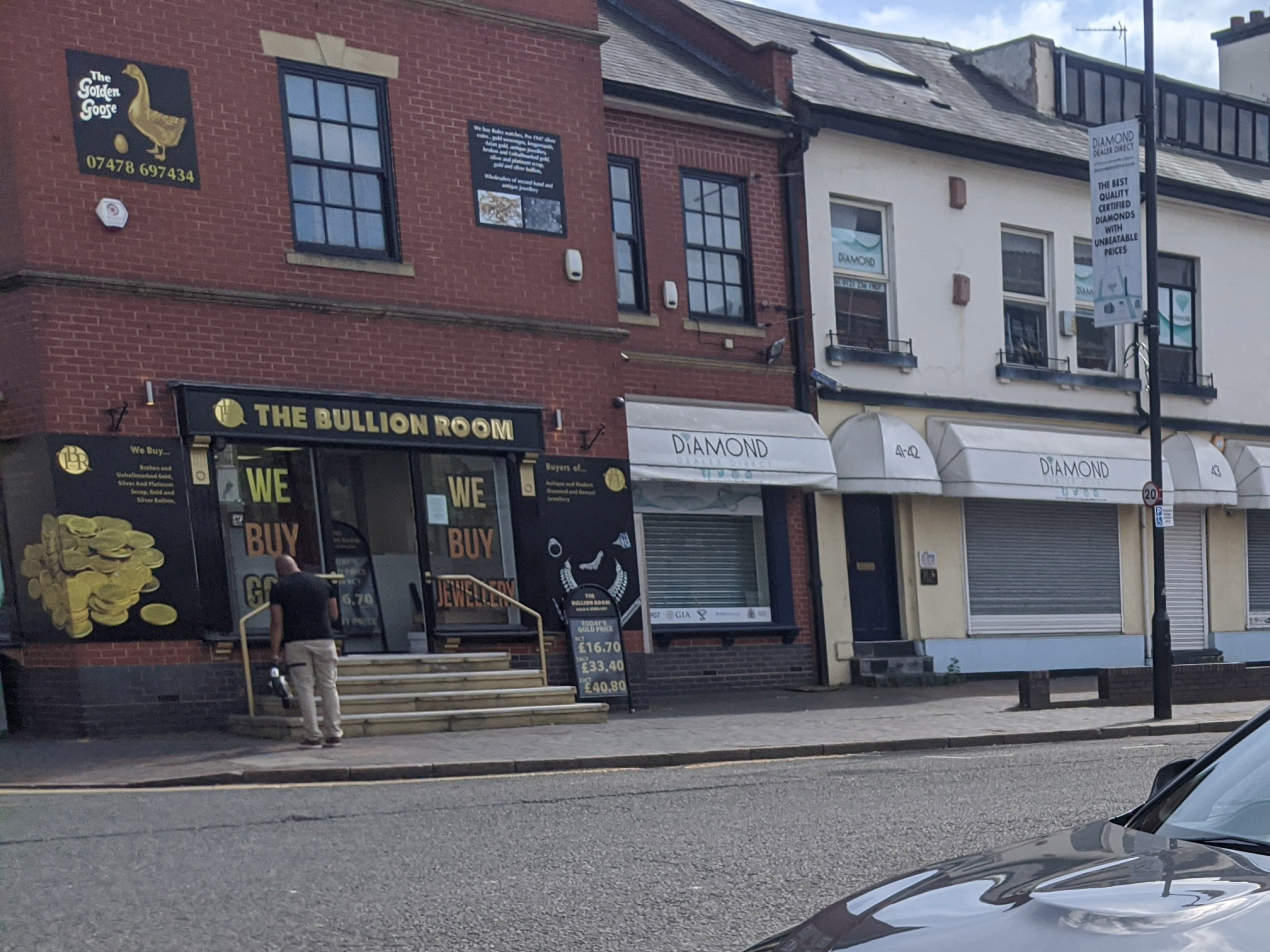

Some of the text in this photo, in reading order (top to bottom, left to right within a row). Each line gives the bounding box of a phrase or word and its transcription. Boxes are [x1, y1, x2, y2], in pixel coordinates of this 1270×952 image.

[90, 70, 112, 82] The
[77, 77, 121, 102] Golden
[79, 98, 117, 121] Goose
[1093, 142, 1134, 158] DEALER DIRECT
[86, 155, 194, 183] 07478 697434
[1098, 177, 1128, 190] THE BEST
[1099, 188, 1130, 202] QUALITY
[1098, 200, 1131, 213] CERTIFIED
[1095, 210, 1136, 224] DIAMONDS
[1104, 223, 1122, 234] WITH
[1094, 232, 1138, 248] UNBEATABLE
[1104, 245, 1127, 257] PRICES
[254, 403, 308, 429] THE
[314, 407, 429, 437] BULLION
[434, 414, 514, 441] ROOM
[130, 445, 145, 455] We
[895, 444, 921, 460] 41-42
[546, 462, 570, 472] Buyers
[676, 457, 772, 468] DEALER DIRECT
[1211, 464, 1222, 478] 43
[245, 467, 292, 504] WE
[448, 476, 487, 509] WE
[1144, 488, 1156, 500] 20
[244, 522, 300, 557] BUY
[448, 527, 494, 560] BUY
[437, 579, 516, 609] JEWELLERY
[675, 611, 691, 619] GIA
[578, 641, 621, 654] £16.70
[581, 660, 625, 674] £33.40
[584, 680, 626, 694] £40.80
